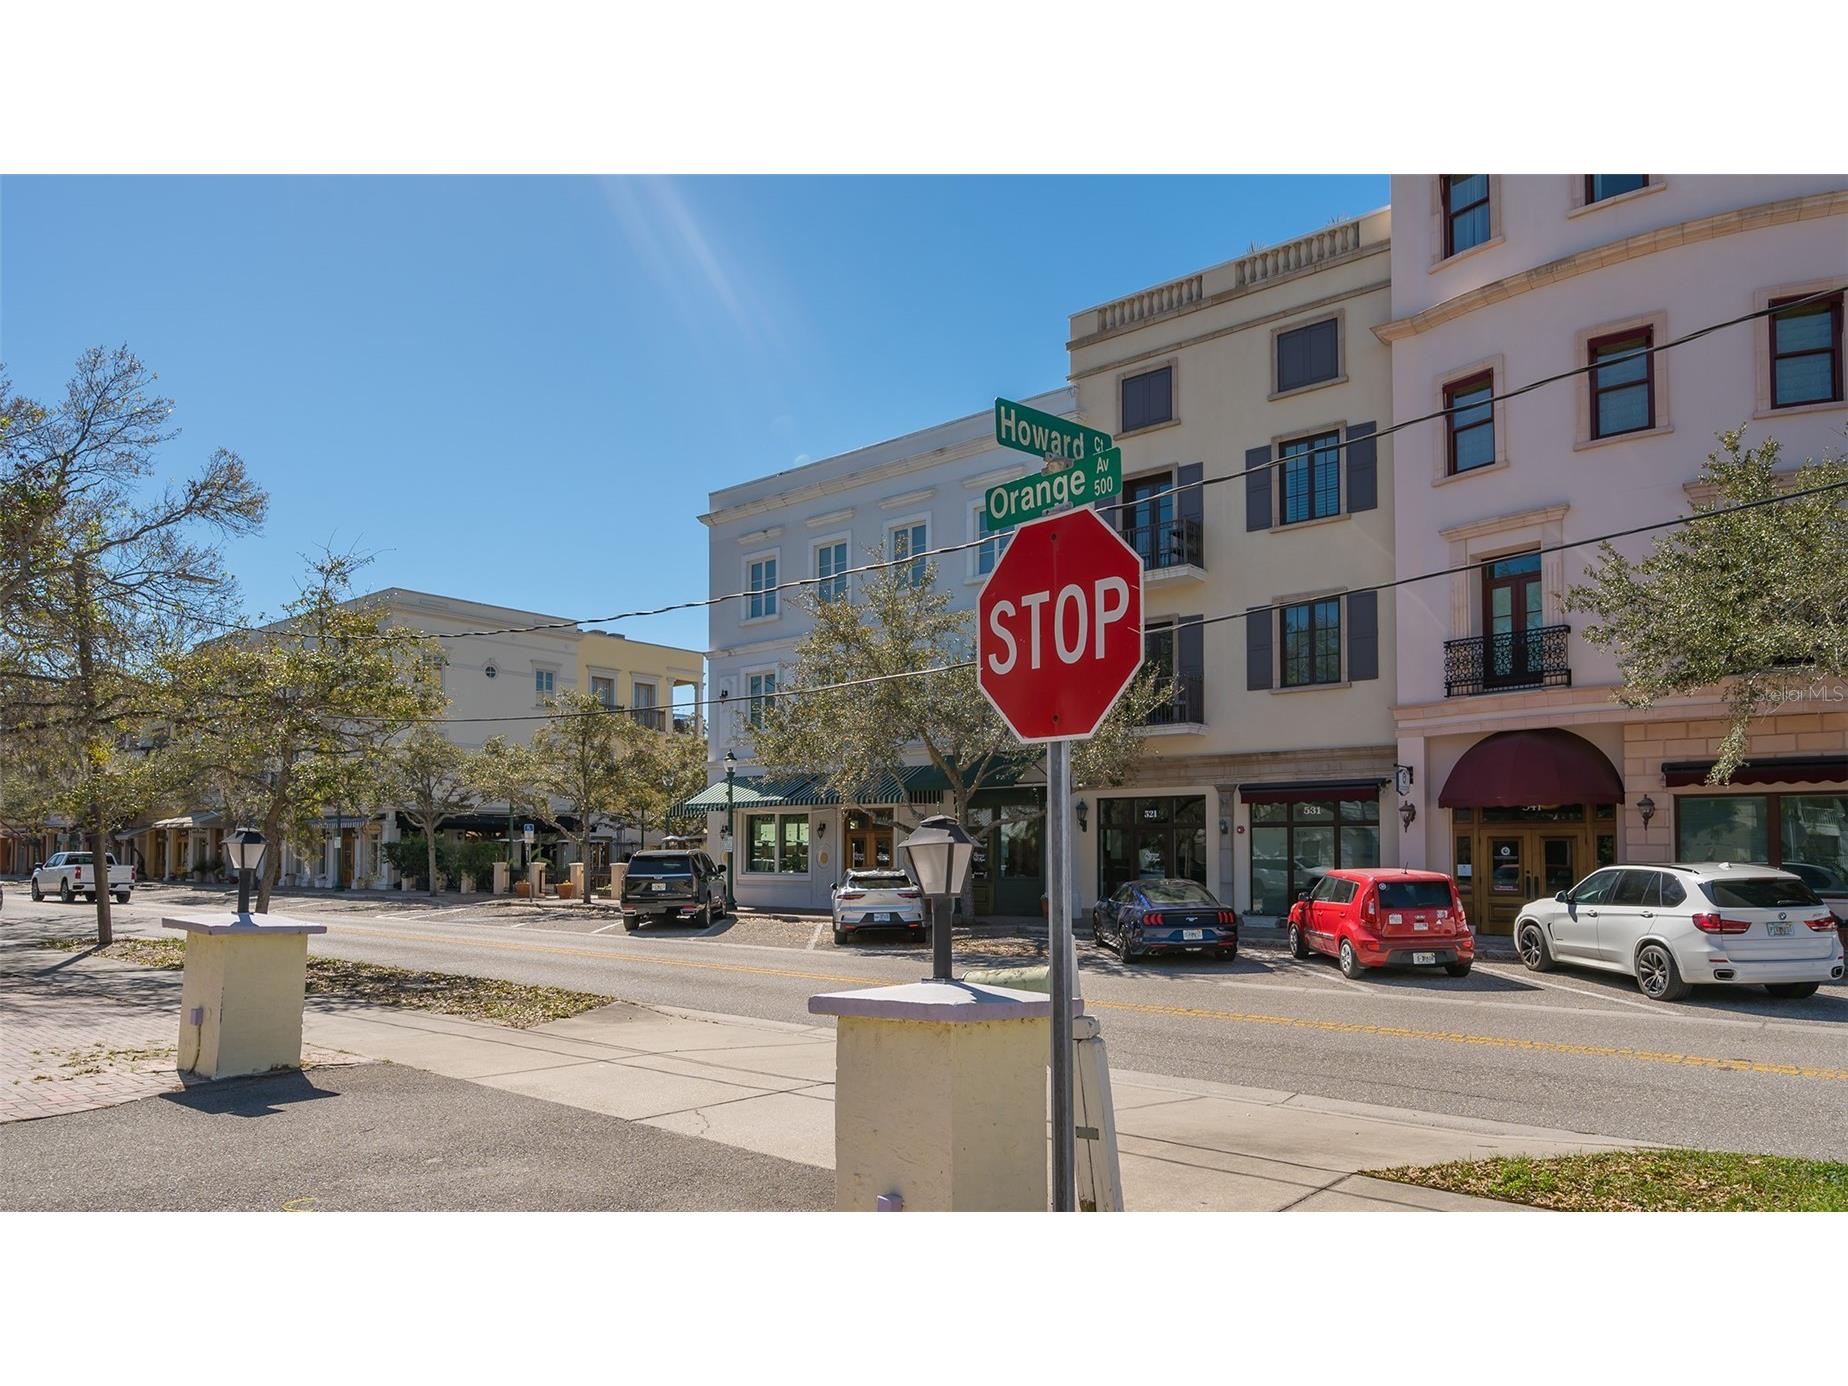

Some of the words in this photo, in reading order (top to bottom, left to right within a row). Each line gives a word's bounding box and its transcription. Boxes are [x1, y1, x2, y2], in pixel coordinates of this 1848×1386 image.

[1001, 406, 1084, 459] Howard
[1094, 436, 1104, 452] Ct
[990, 470, 1085, 519] Orange
[1096, 457, 1109, 474] Av
[1094, 476, 1112, 496] 500
[988, 576, 1130, 675] STOP
[1303, 806, 1321, 814] 531
